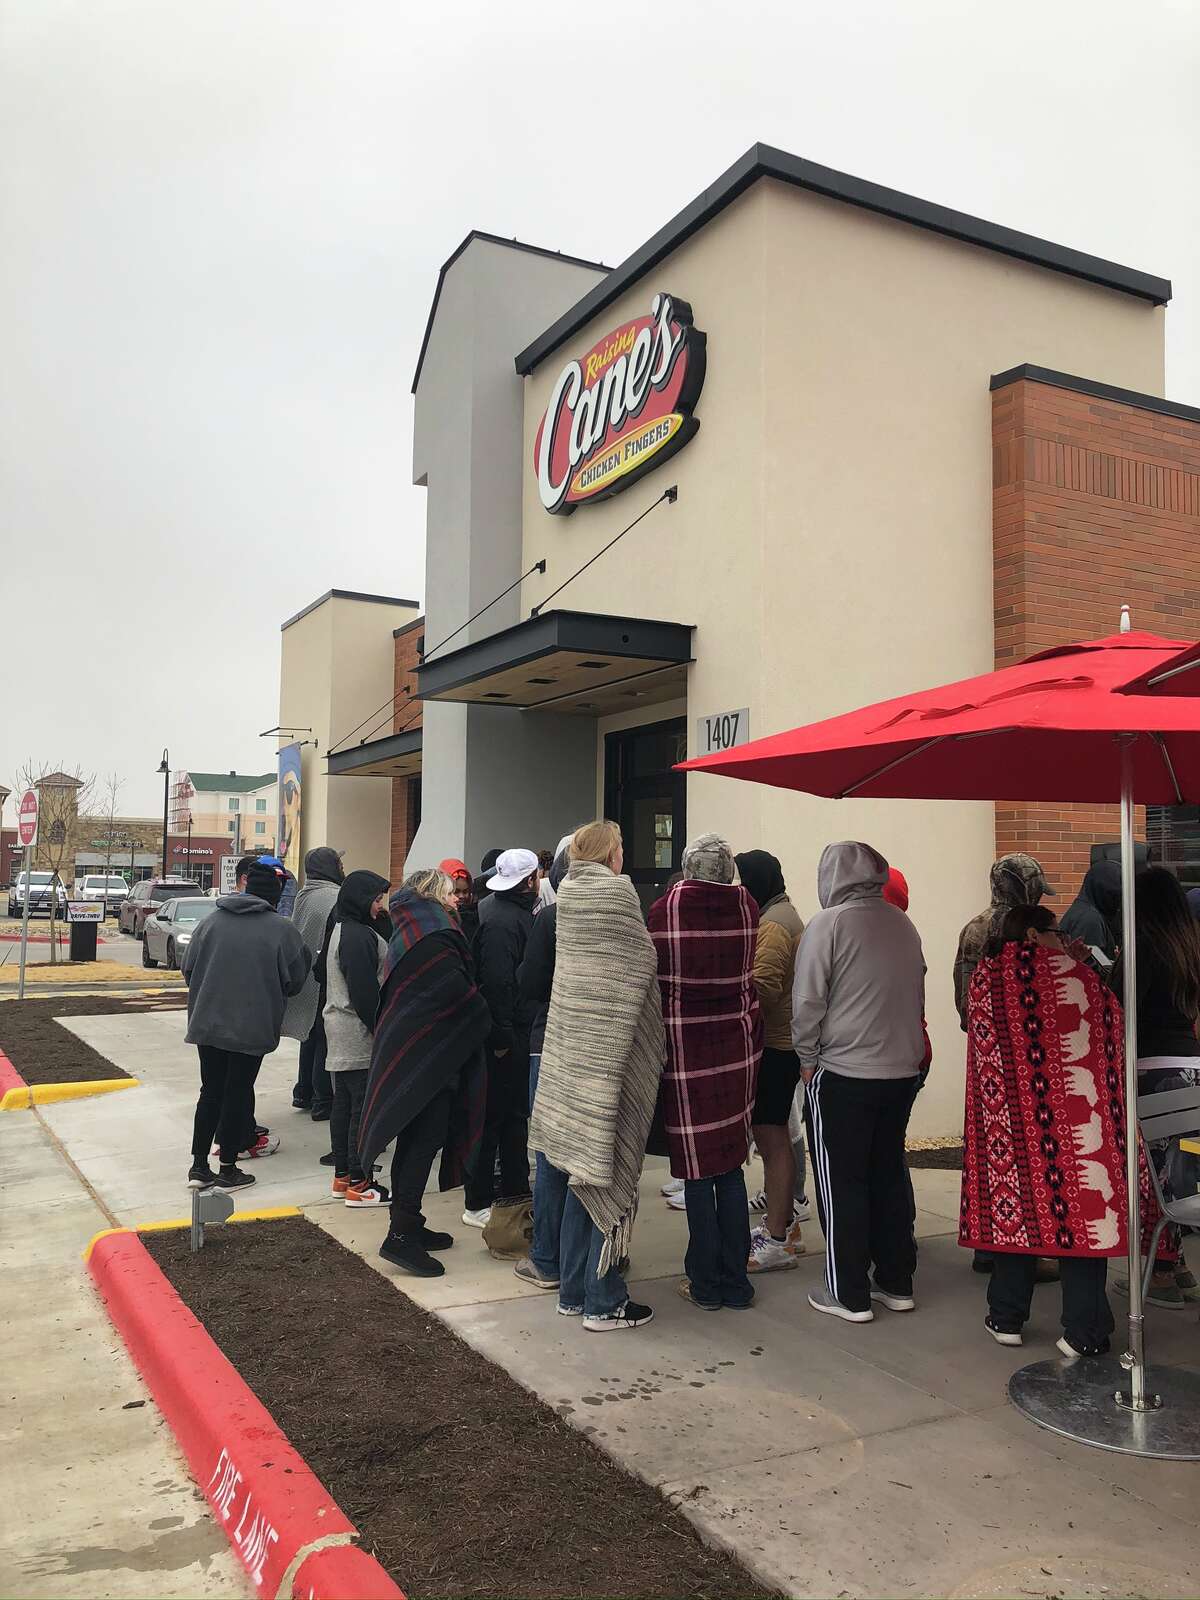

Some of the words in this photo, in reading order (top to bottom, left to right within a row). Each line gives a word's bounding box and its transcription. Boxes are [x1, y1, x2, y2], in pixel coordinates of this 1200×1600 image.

[585, 325, 636, 386] Raising
[538, 293, 685, 509] Cane's
[580, 450, 621, 489] CHICKEN
[624, 419, 671, 461] FINGERS
[705, 713, 740, 751] 1407
[207, 1447, 243, 1520] FIRE
[233, 1492, 279, 1586] LANE
